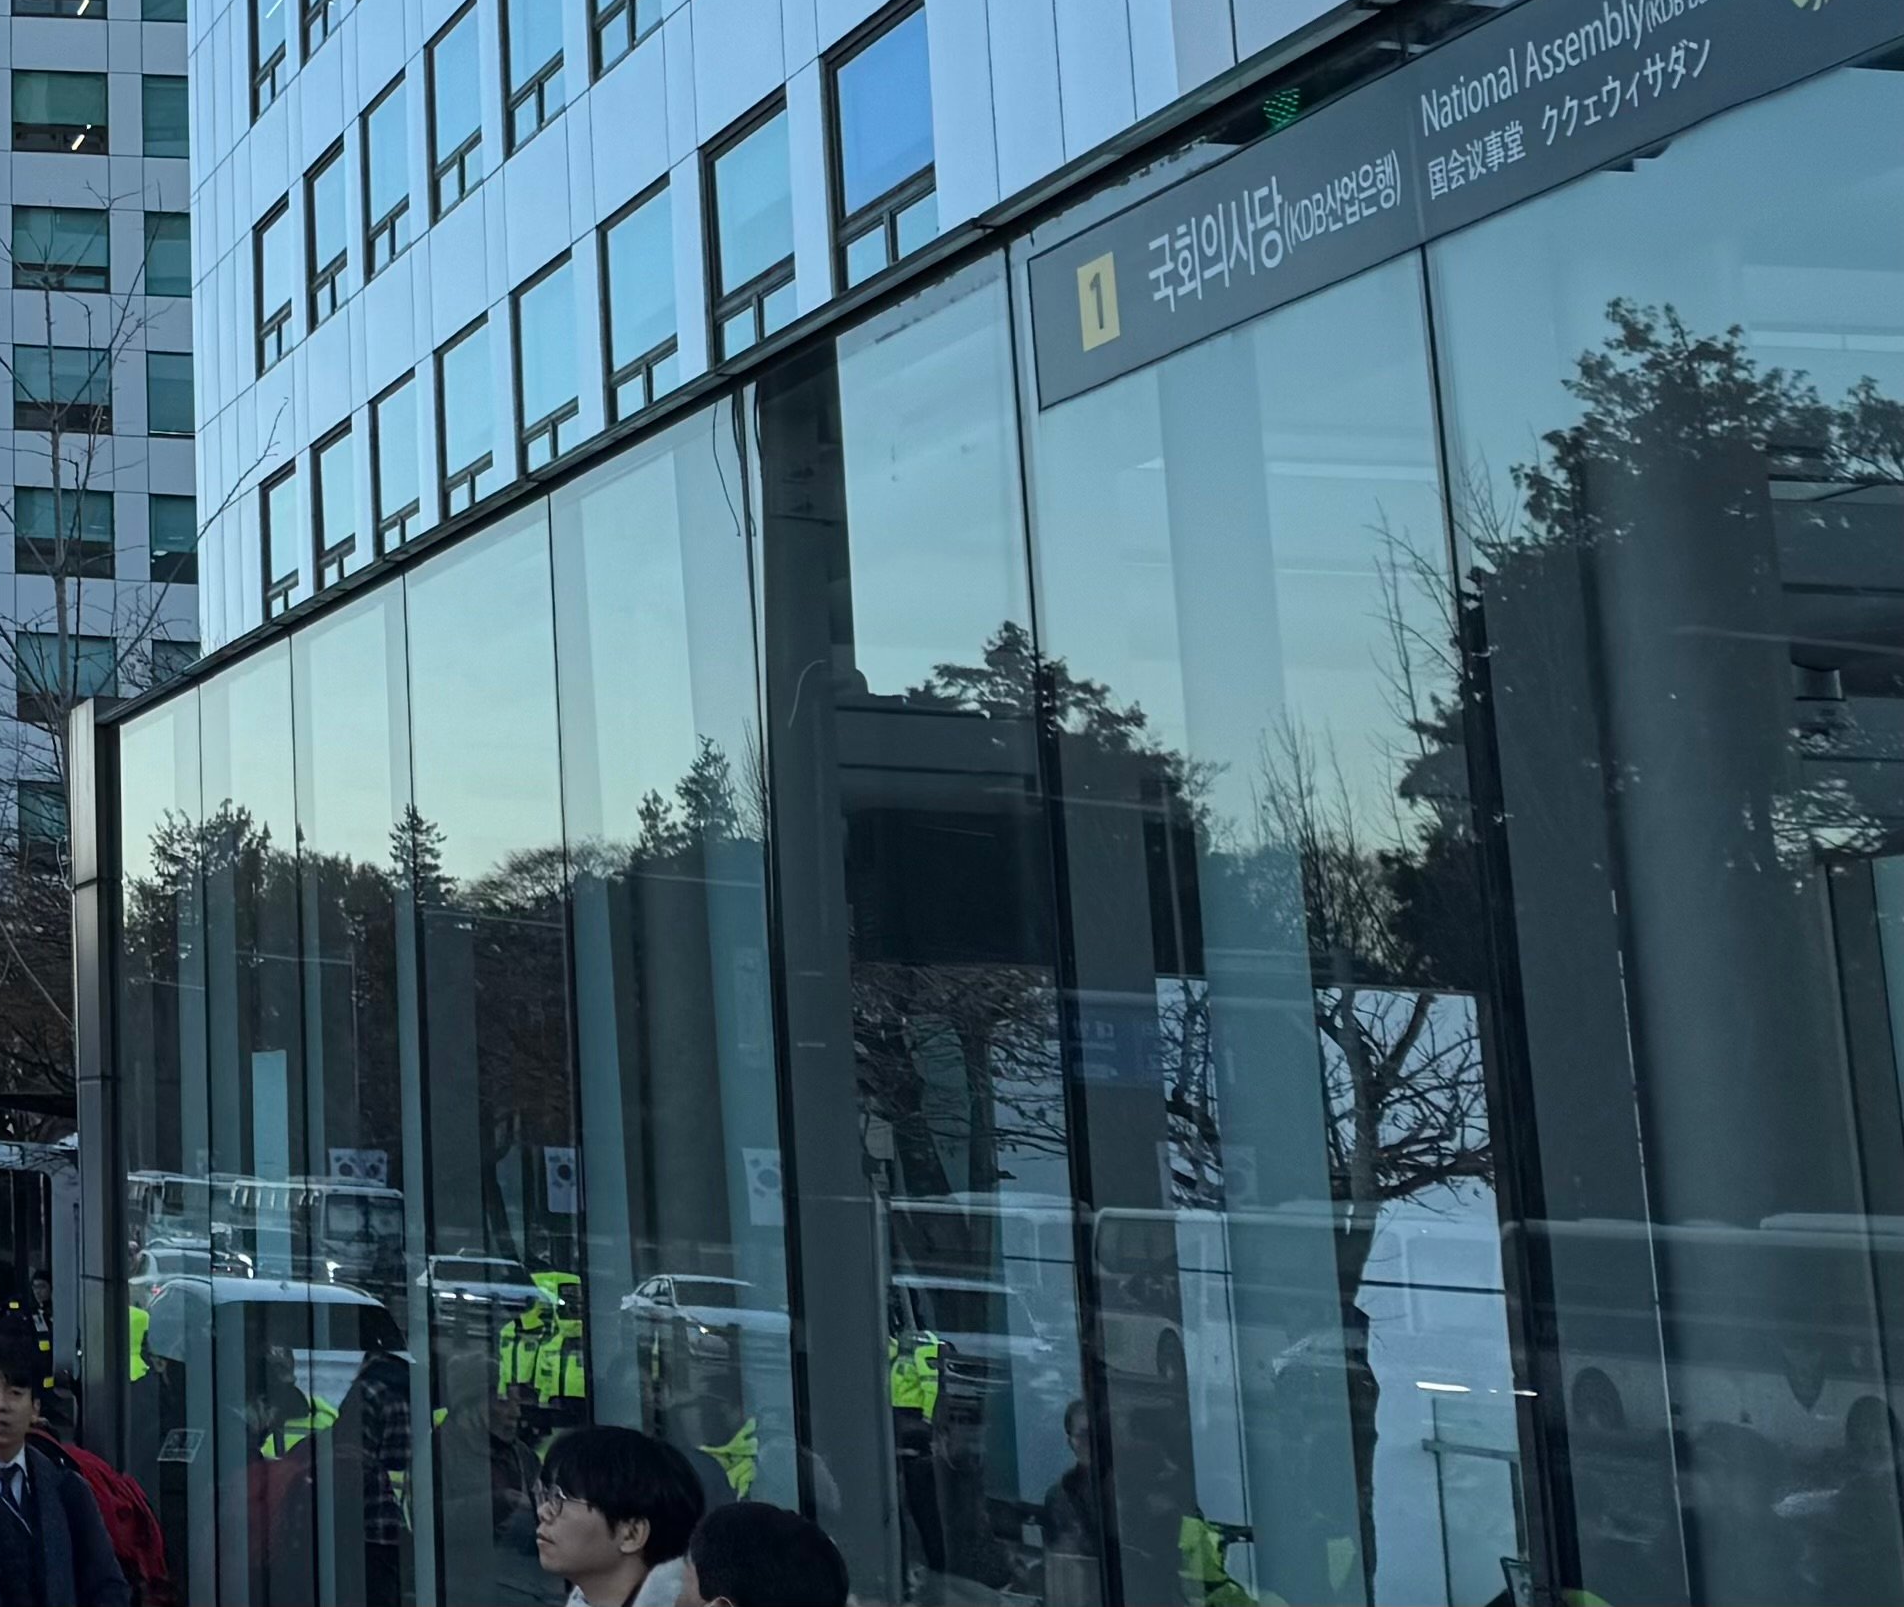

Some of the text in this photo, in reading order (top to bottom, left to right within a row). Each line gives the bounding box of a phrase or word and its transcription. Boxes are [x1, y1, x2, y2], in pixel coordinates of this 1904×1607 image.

[1420, 48, 1519, 137] National
[1427, 120, 1526, 200] 国会议事堂
[1089, 271, 1104, 330] 1
